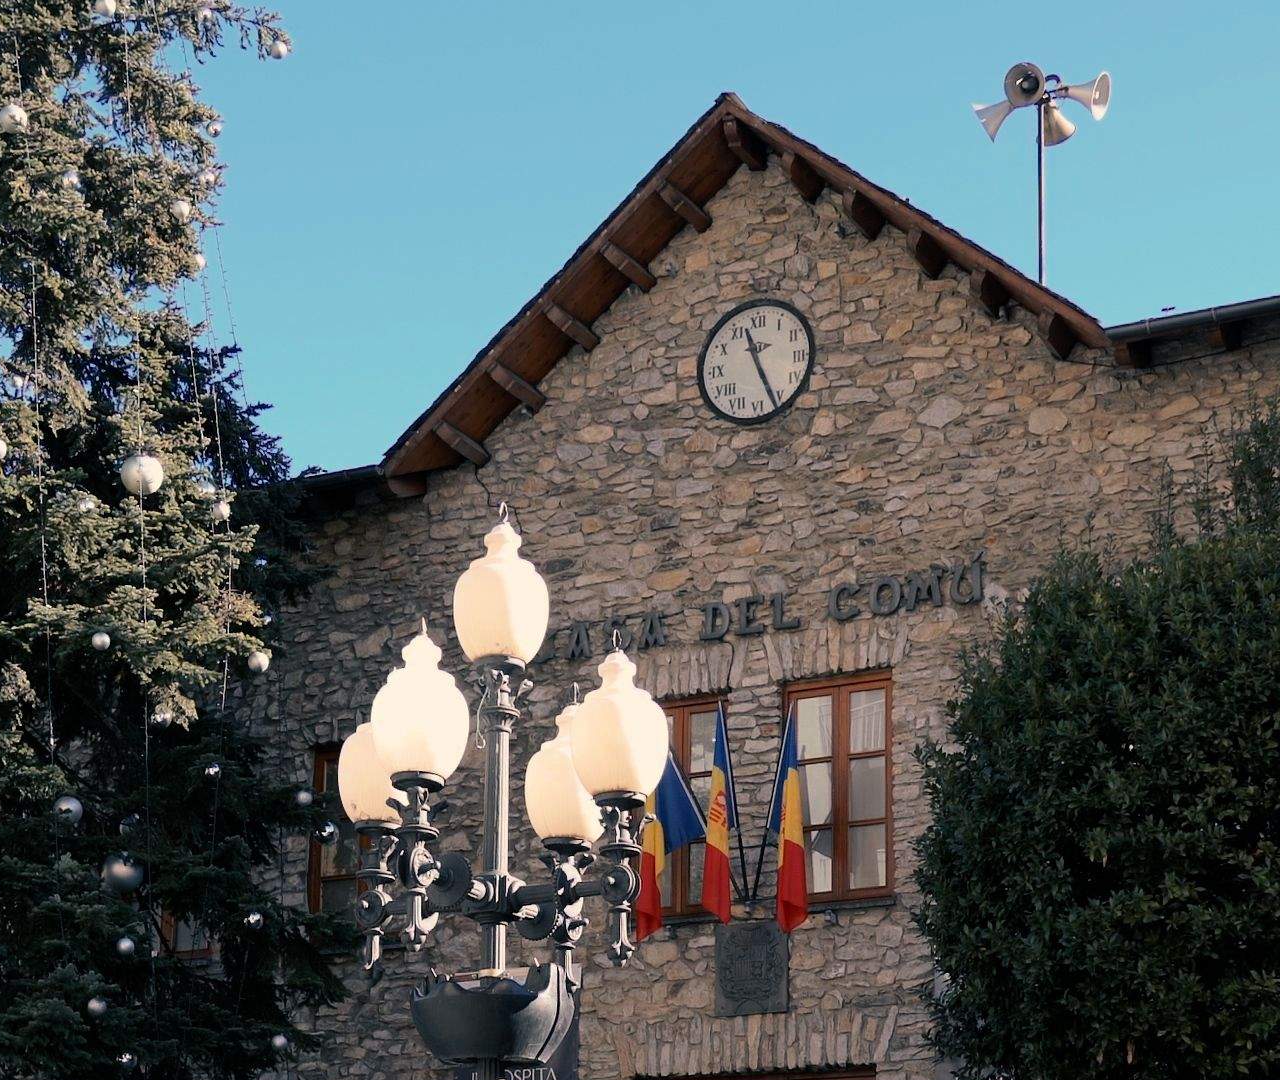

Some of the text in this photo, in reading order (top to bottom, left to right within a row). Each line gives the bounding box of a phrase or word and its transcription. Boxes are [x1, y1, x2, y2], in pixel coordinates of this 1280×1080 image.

[750, 315, 766, 329] XII
[777, 319, 781, 331] I
[731, 327, 743, 340] XI
[789, 329, 798, 342] II
[720, 343, 728, 356] X
[793, 349, 805, 363] III
[712, 365, 724, 379] IX
[715, 383, 736, 397] VIII
[776, 390, 784, 401] V
[728, 397, 745, 411] VII
[751, 400, 764, 413] VI
[699, 592, 801, 641] DEL
[828, 551, 987, 620] COMÚ
